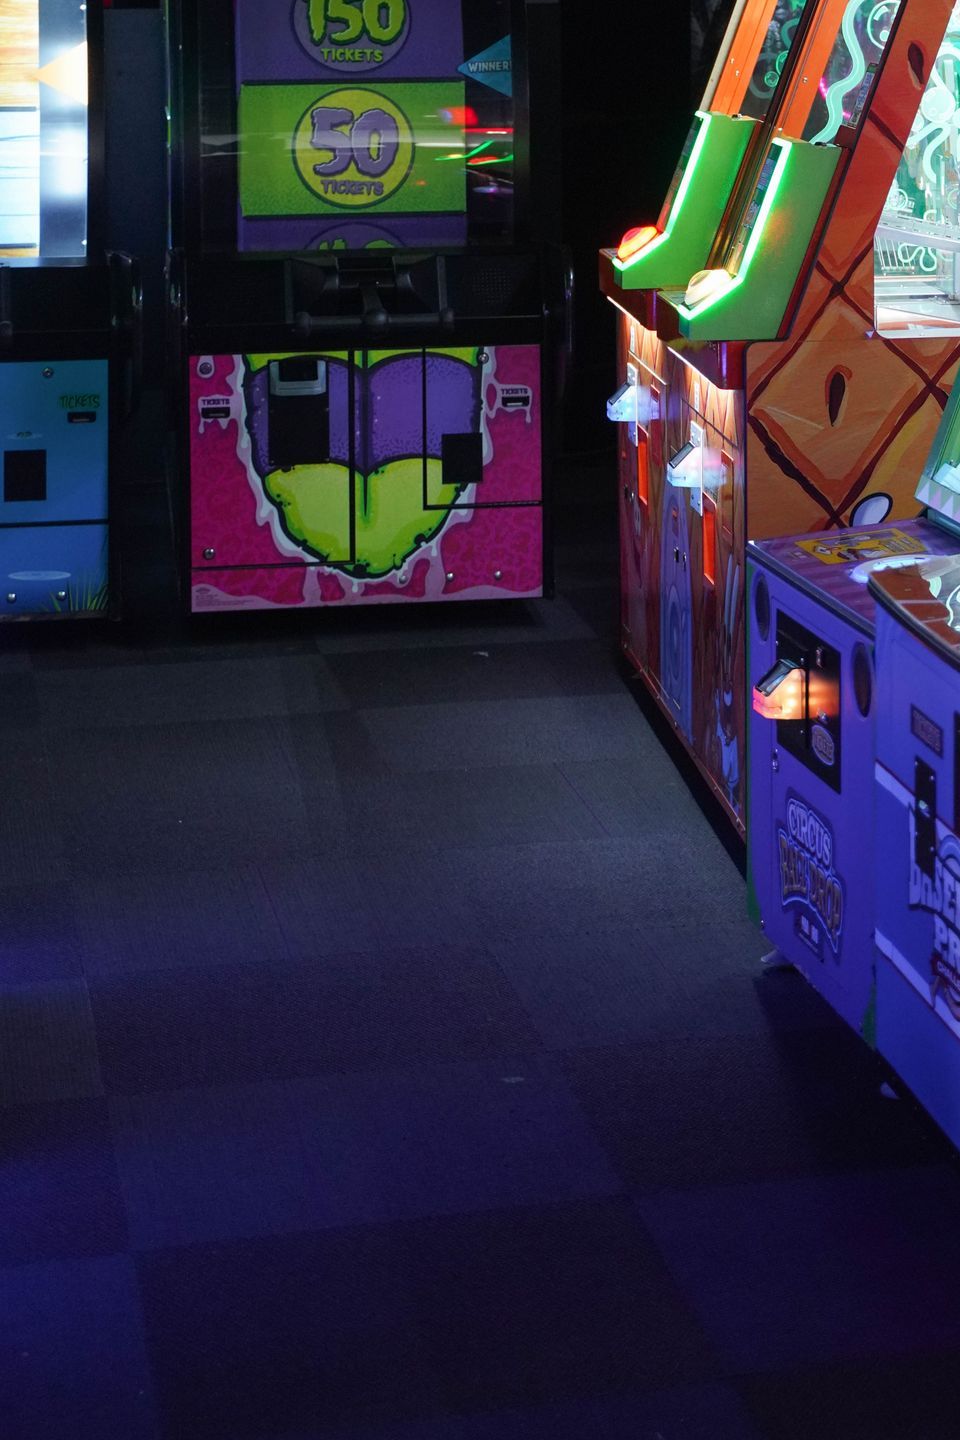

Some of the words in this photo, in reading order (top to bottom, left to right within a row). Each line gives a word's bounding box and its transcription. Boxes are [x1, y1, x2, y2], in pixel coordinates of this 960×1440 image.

[319, 47, 384, 62] TICKETS
[309, 106, 400, 177] 50
[319, 179, 385, 196] TICKETS
[59, 393, 100, 409] TICKETS
[201, 398, 231, 406] TICKETS
[787, 797, 832, 867] CIRCUS
